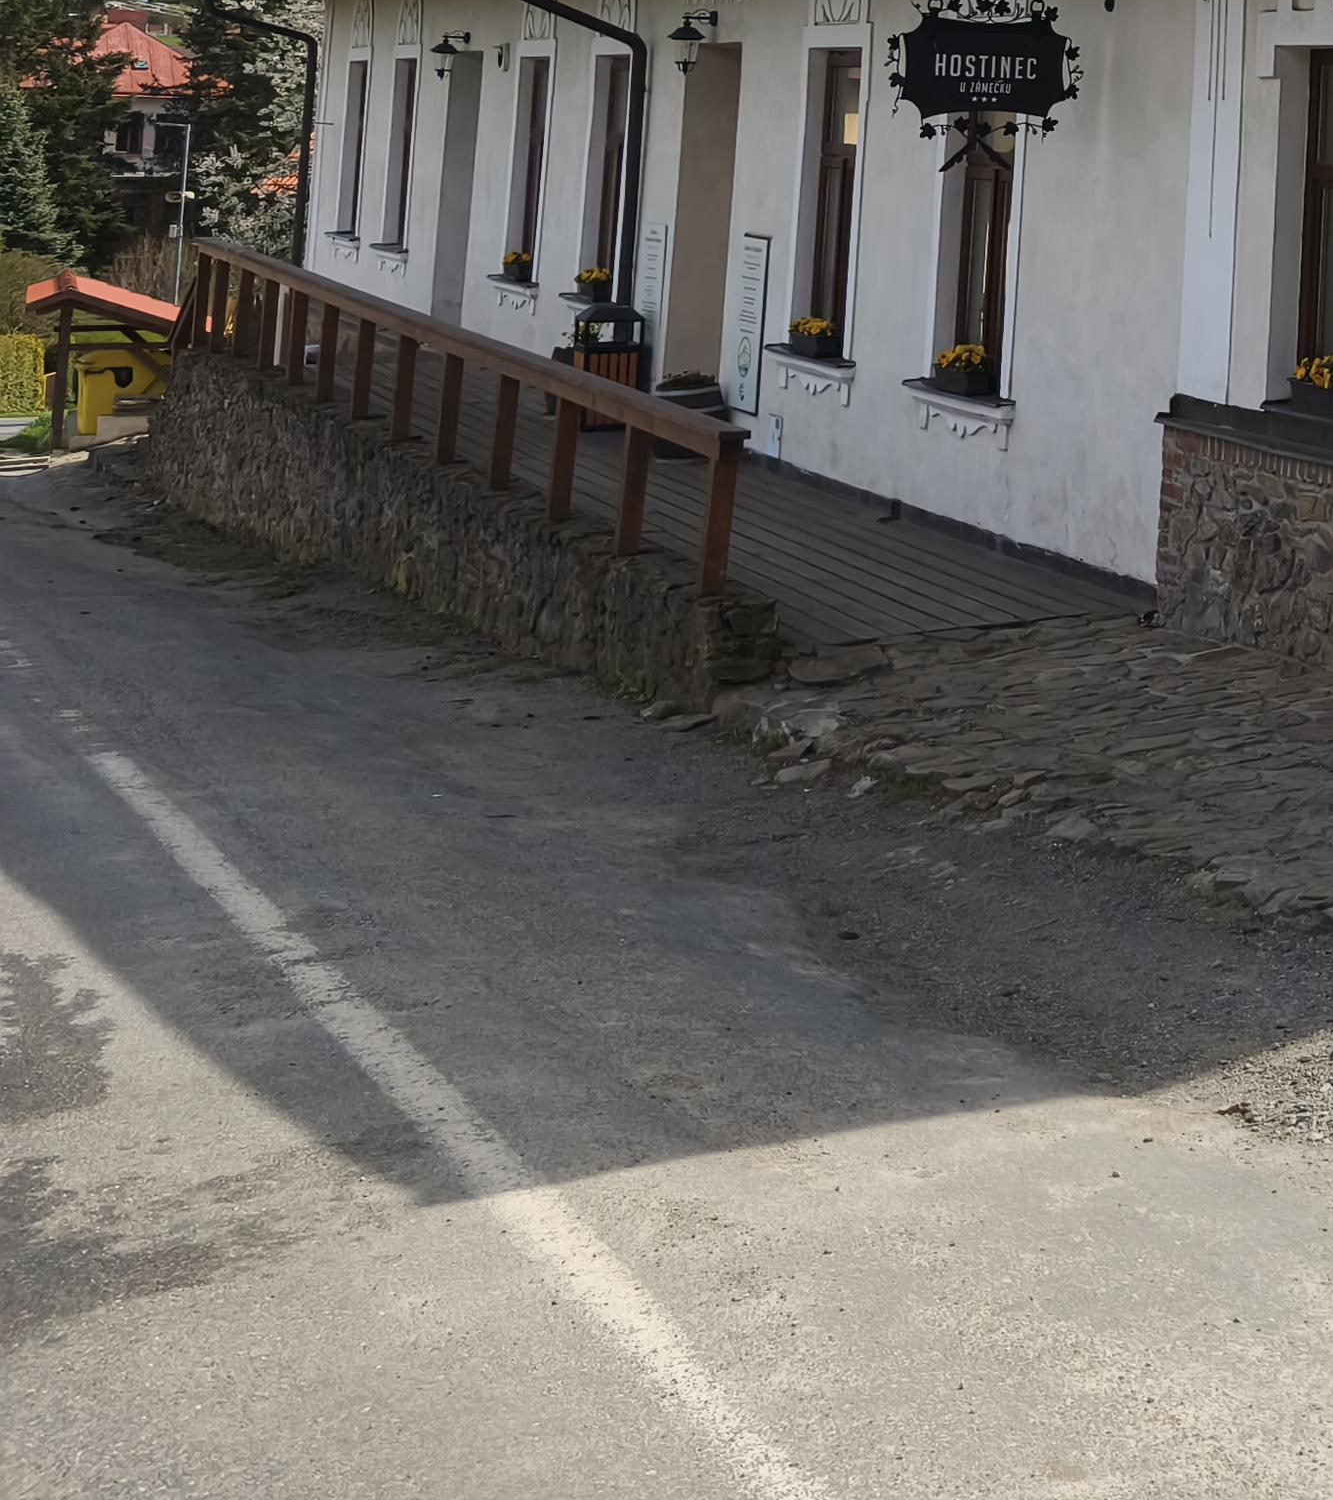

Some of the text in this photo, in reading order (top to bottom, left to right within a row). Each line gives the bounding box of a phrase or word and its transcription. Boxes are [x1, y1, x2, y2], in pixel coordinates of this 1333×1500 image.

[935, 53, 1037, 79] HOSTINEC
[960, 79, 1012, 94] U ZÁMEČKU
